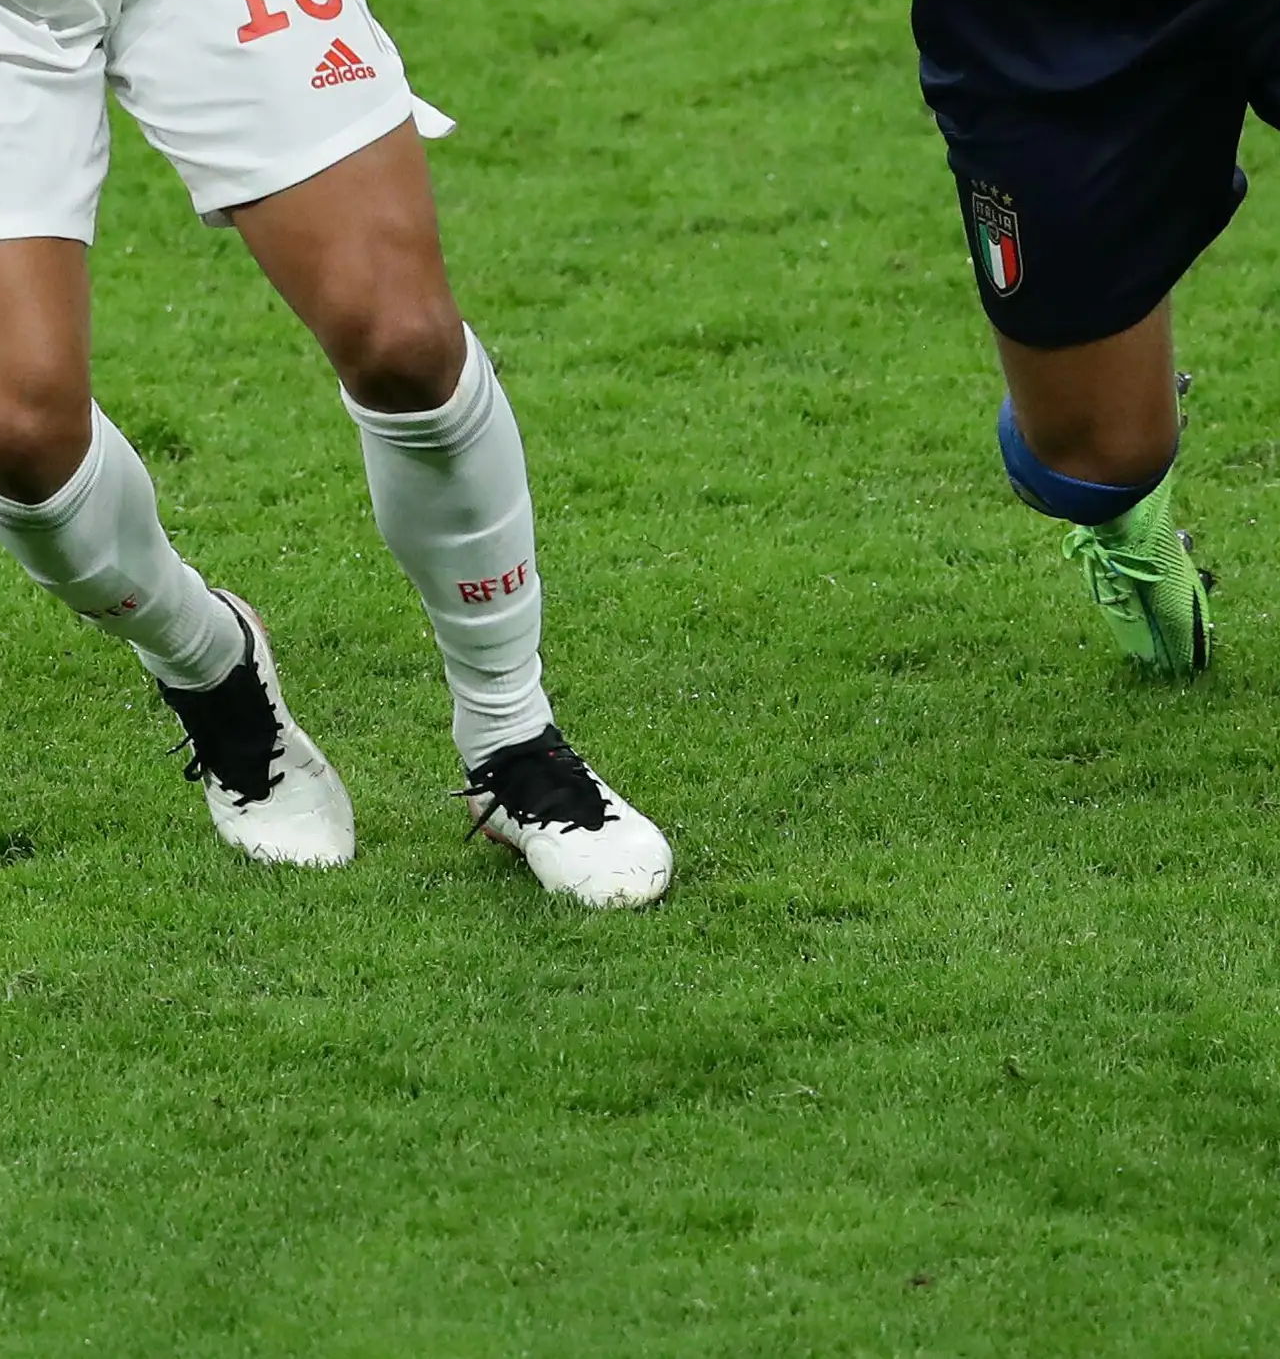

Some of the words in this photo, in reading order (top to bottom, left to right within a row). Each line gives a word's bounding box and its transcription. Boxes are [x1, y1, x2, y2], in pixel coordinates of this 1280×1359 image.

[311, 64, 376, 89] adidas
[976, 201, 1012, 231] ITALIA
[457, 559, 528, 604] RFEF
